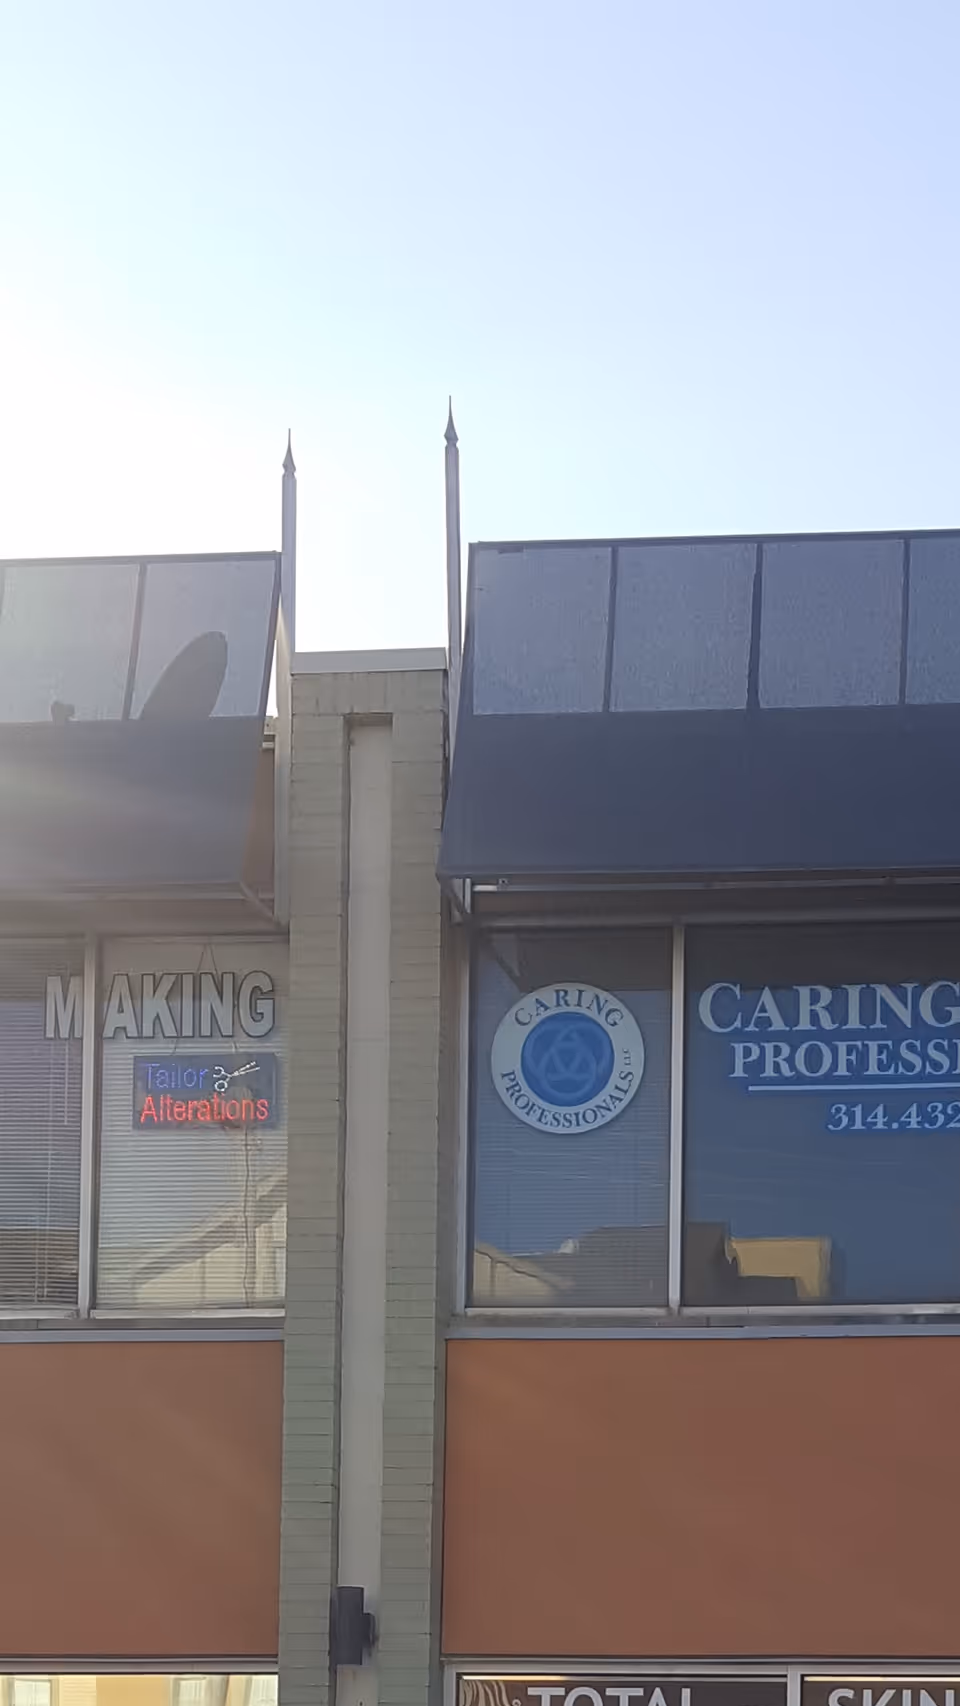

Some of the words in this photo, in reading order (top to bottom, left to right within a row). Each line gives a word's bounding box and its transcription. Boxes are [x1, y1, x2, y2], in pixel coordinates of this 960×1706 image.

[44, 970, 276, 1040] MAKING
[513, 988, 625, 1028] CARING
[143, 1063, 208, 1090] Tailor
[139, 1094, 270, 1124] Alterations
[501, 1069, 635, 1128] PROFESSIONALS
